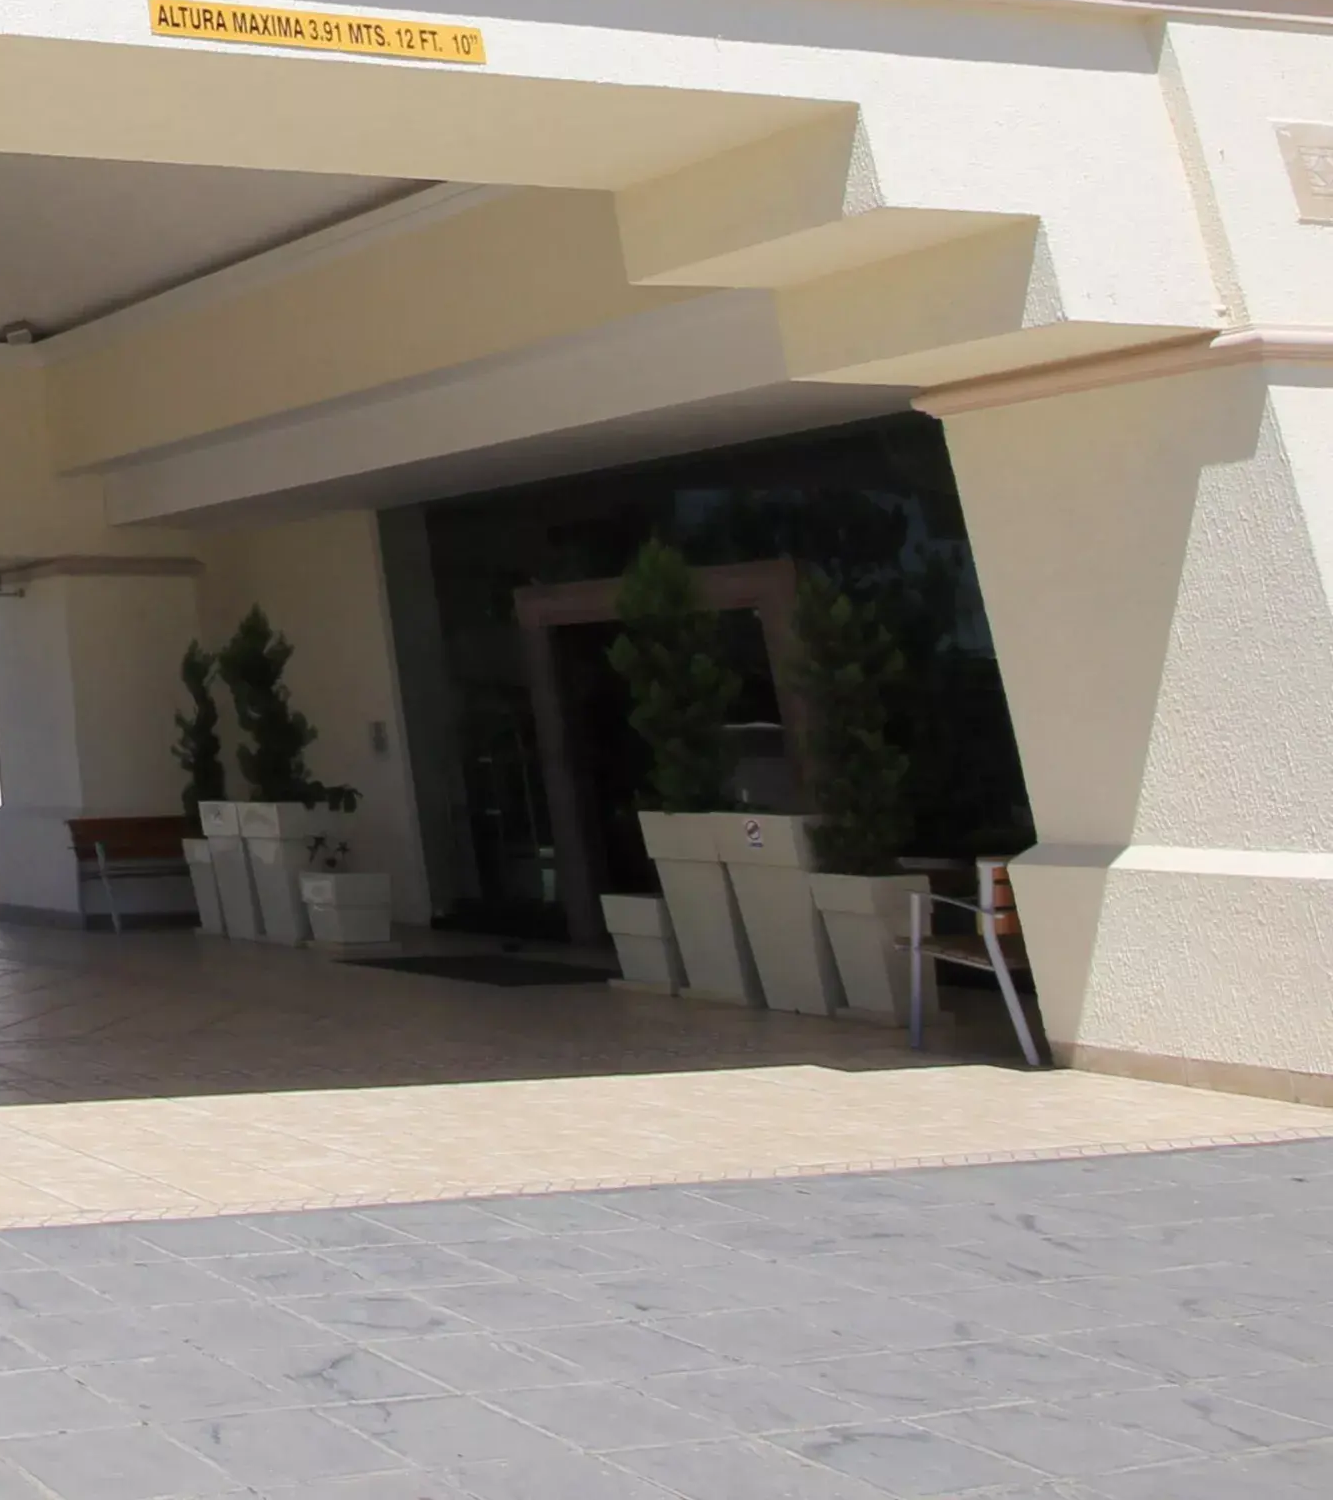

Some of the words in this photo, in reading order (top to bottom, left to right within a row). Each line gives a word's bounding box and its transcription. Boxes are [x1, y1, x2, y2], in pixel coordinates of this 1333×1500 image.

[158, 4, 227, 32] ALTURA
[232, 11, 305, 39] MAXIMA
[309, 20, 341, 43] 3.91
[348, 23, 391, 48] MTS.
[395, 28, 415, 49] 12
[420, 30, 443, 52] FT.
